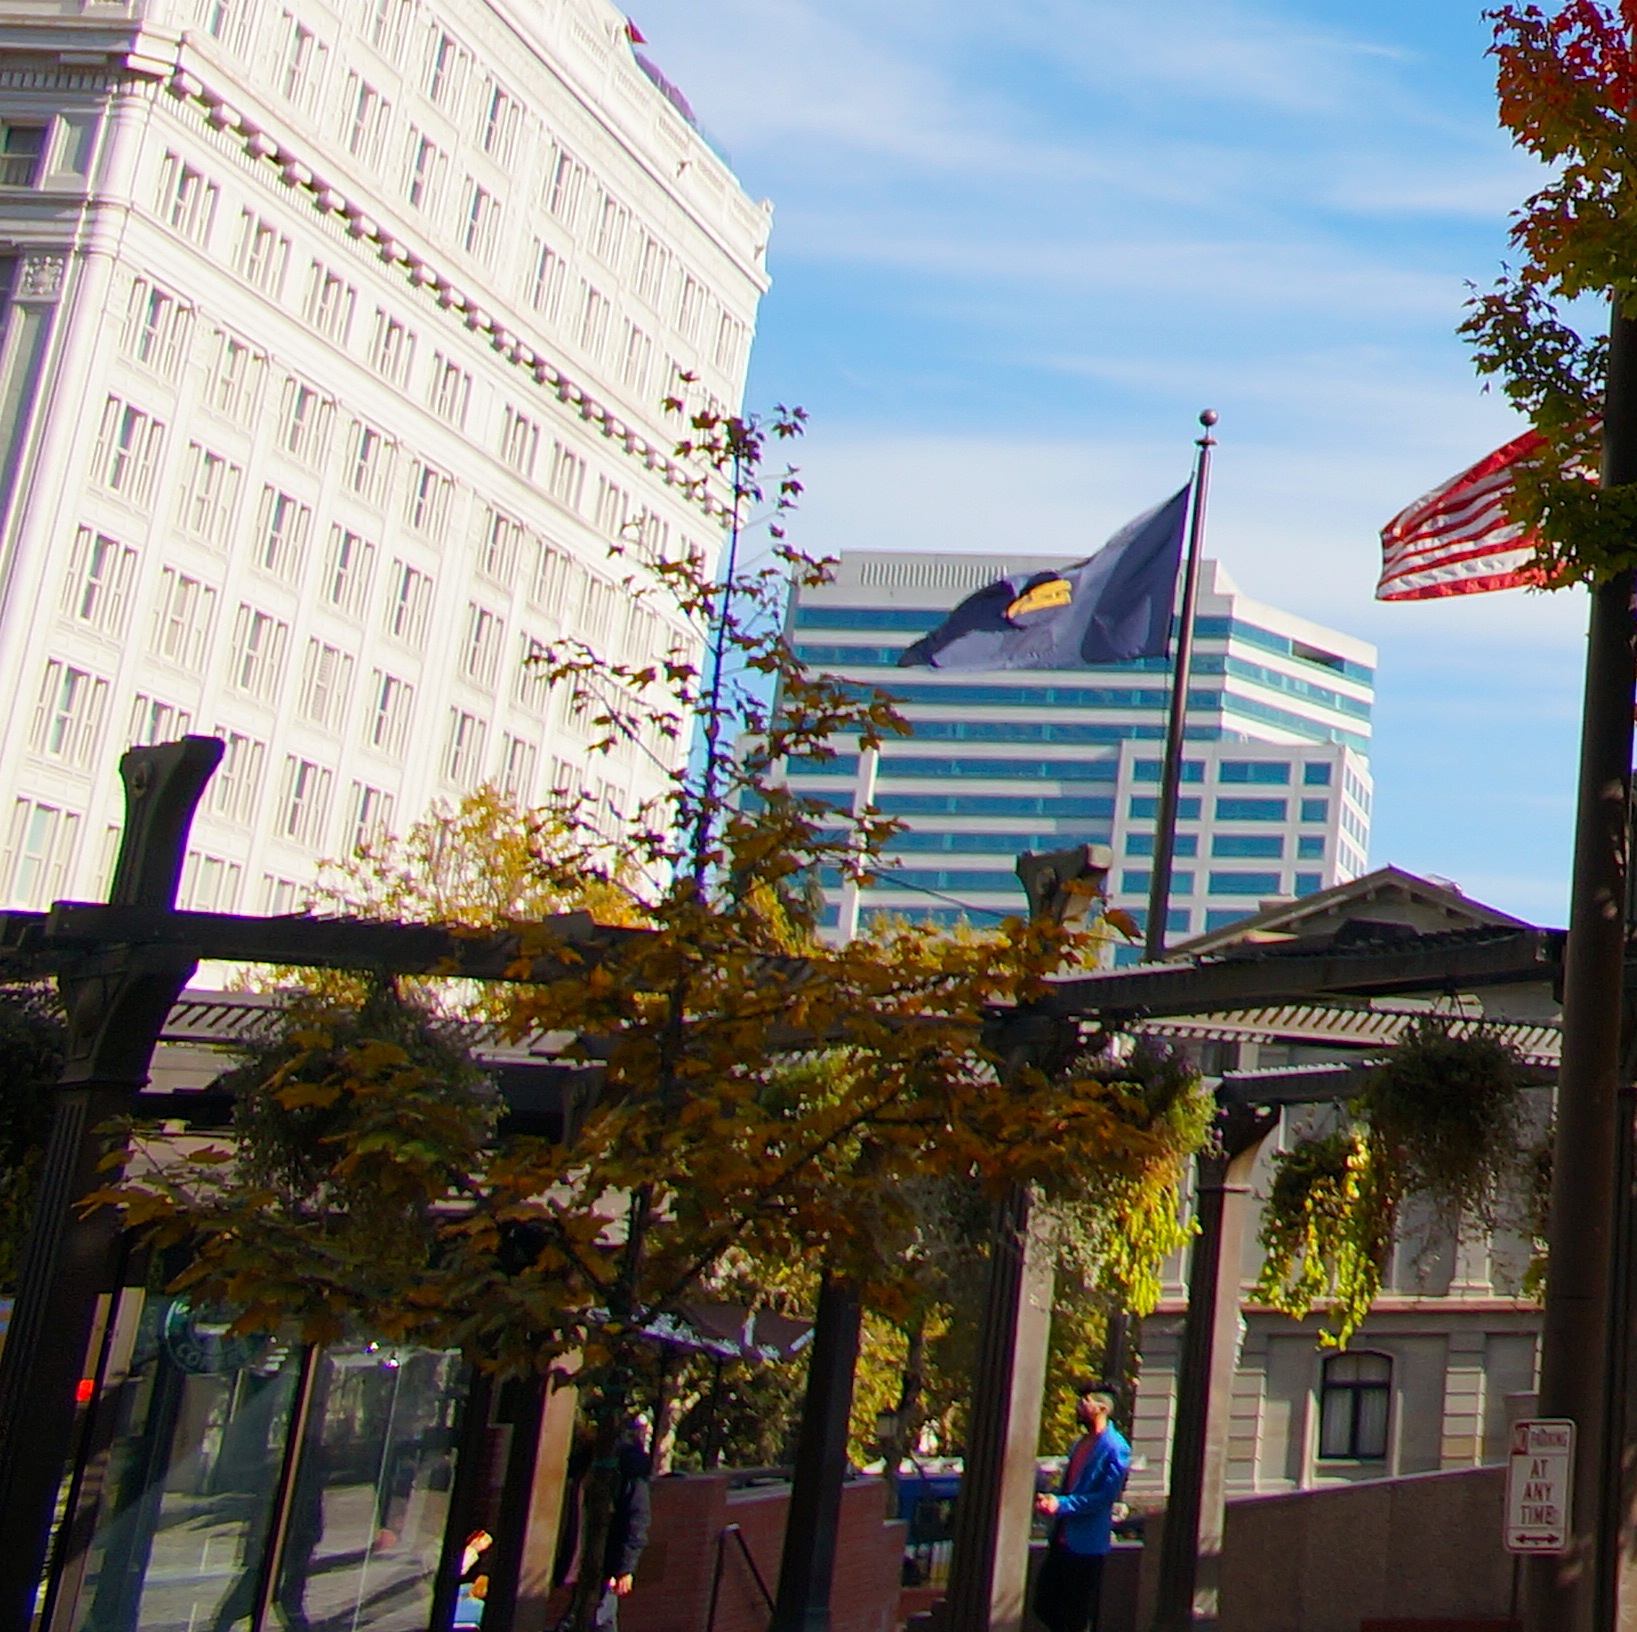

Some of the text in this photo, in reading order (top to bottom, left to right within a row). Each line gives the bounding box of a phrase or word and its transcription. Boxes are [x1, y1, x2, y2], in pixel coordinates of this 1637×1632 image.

[1530, 1458, 1549, 1479] AT
[1523, 1482, 1554, 1501] ANY
[1520, 1505, 1556, 1525] TIME
